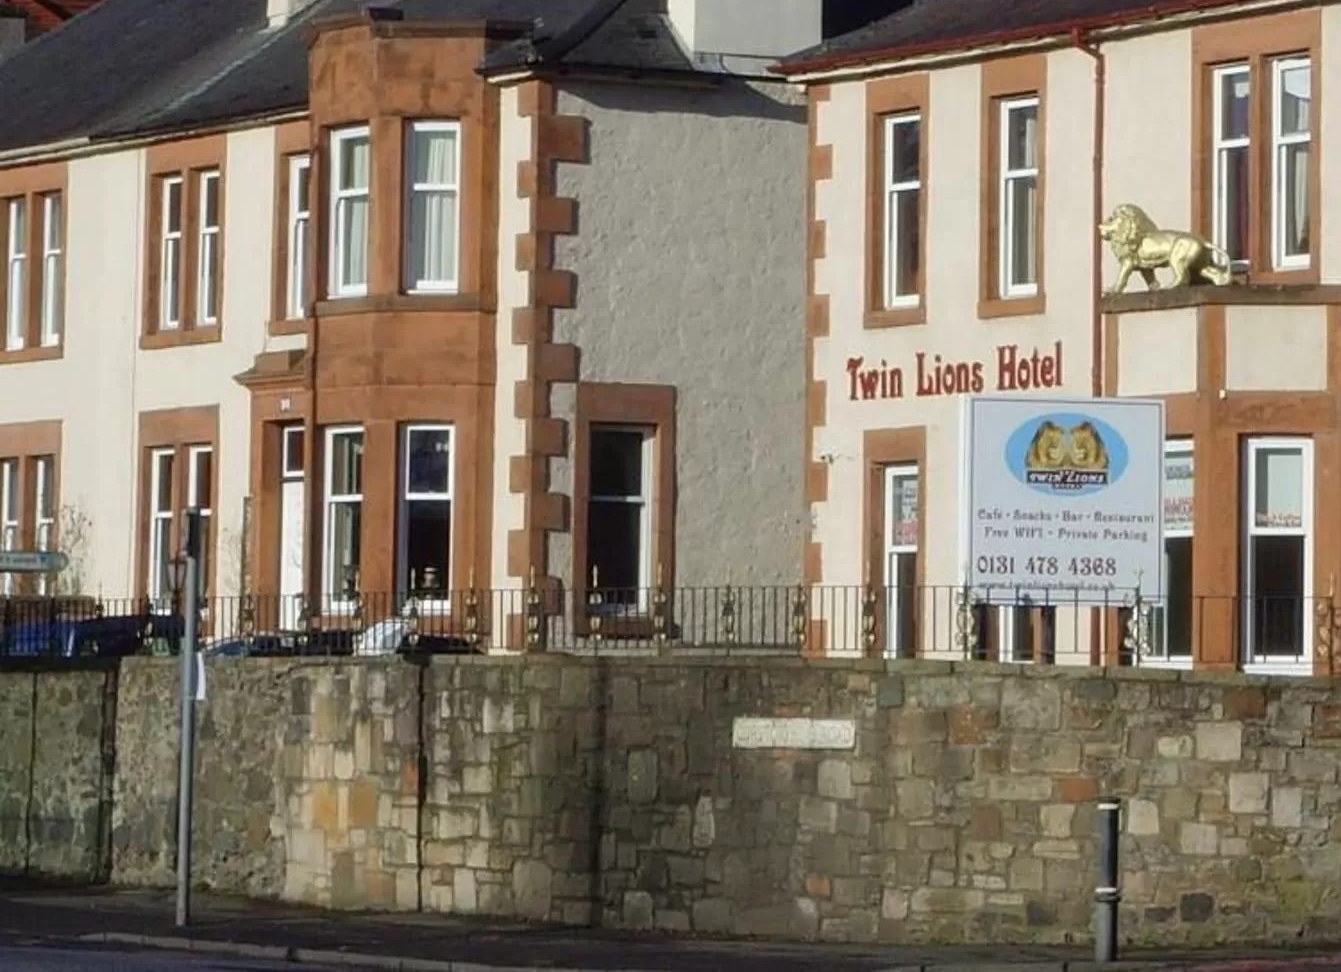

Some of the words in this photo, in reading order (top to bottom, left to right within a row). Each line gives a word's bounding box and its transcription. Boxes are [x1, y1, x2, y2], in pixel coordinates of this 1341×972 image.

[846, 356, 904, 401] Twin
[915, 351, 985, 397] Lions
[996, 340, 1063, 391] Hotel
[1012, 508, 1053, 522] Snacks
[1061, 510, 1084, 523] Bar
[1093, 511, 1156, 524] Restaurant
[983, 526, 1009, 539] Free
[1057, 527, 1100, 540] Private
[1102, 527, 1148, 544] Parking
[977, 555, 1015, 575] 0131
[1025, 555, 1059, 576] 478
[1067, 556, 1118, 577] 4368
